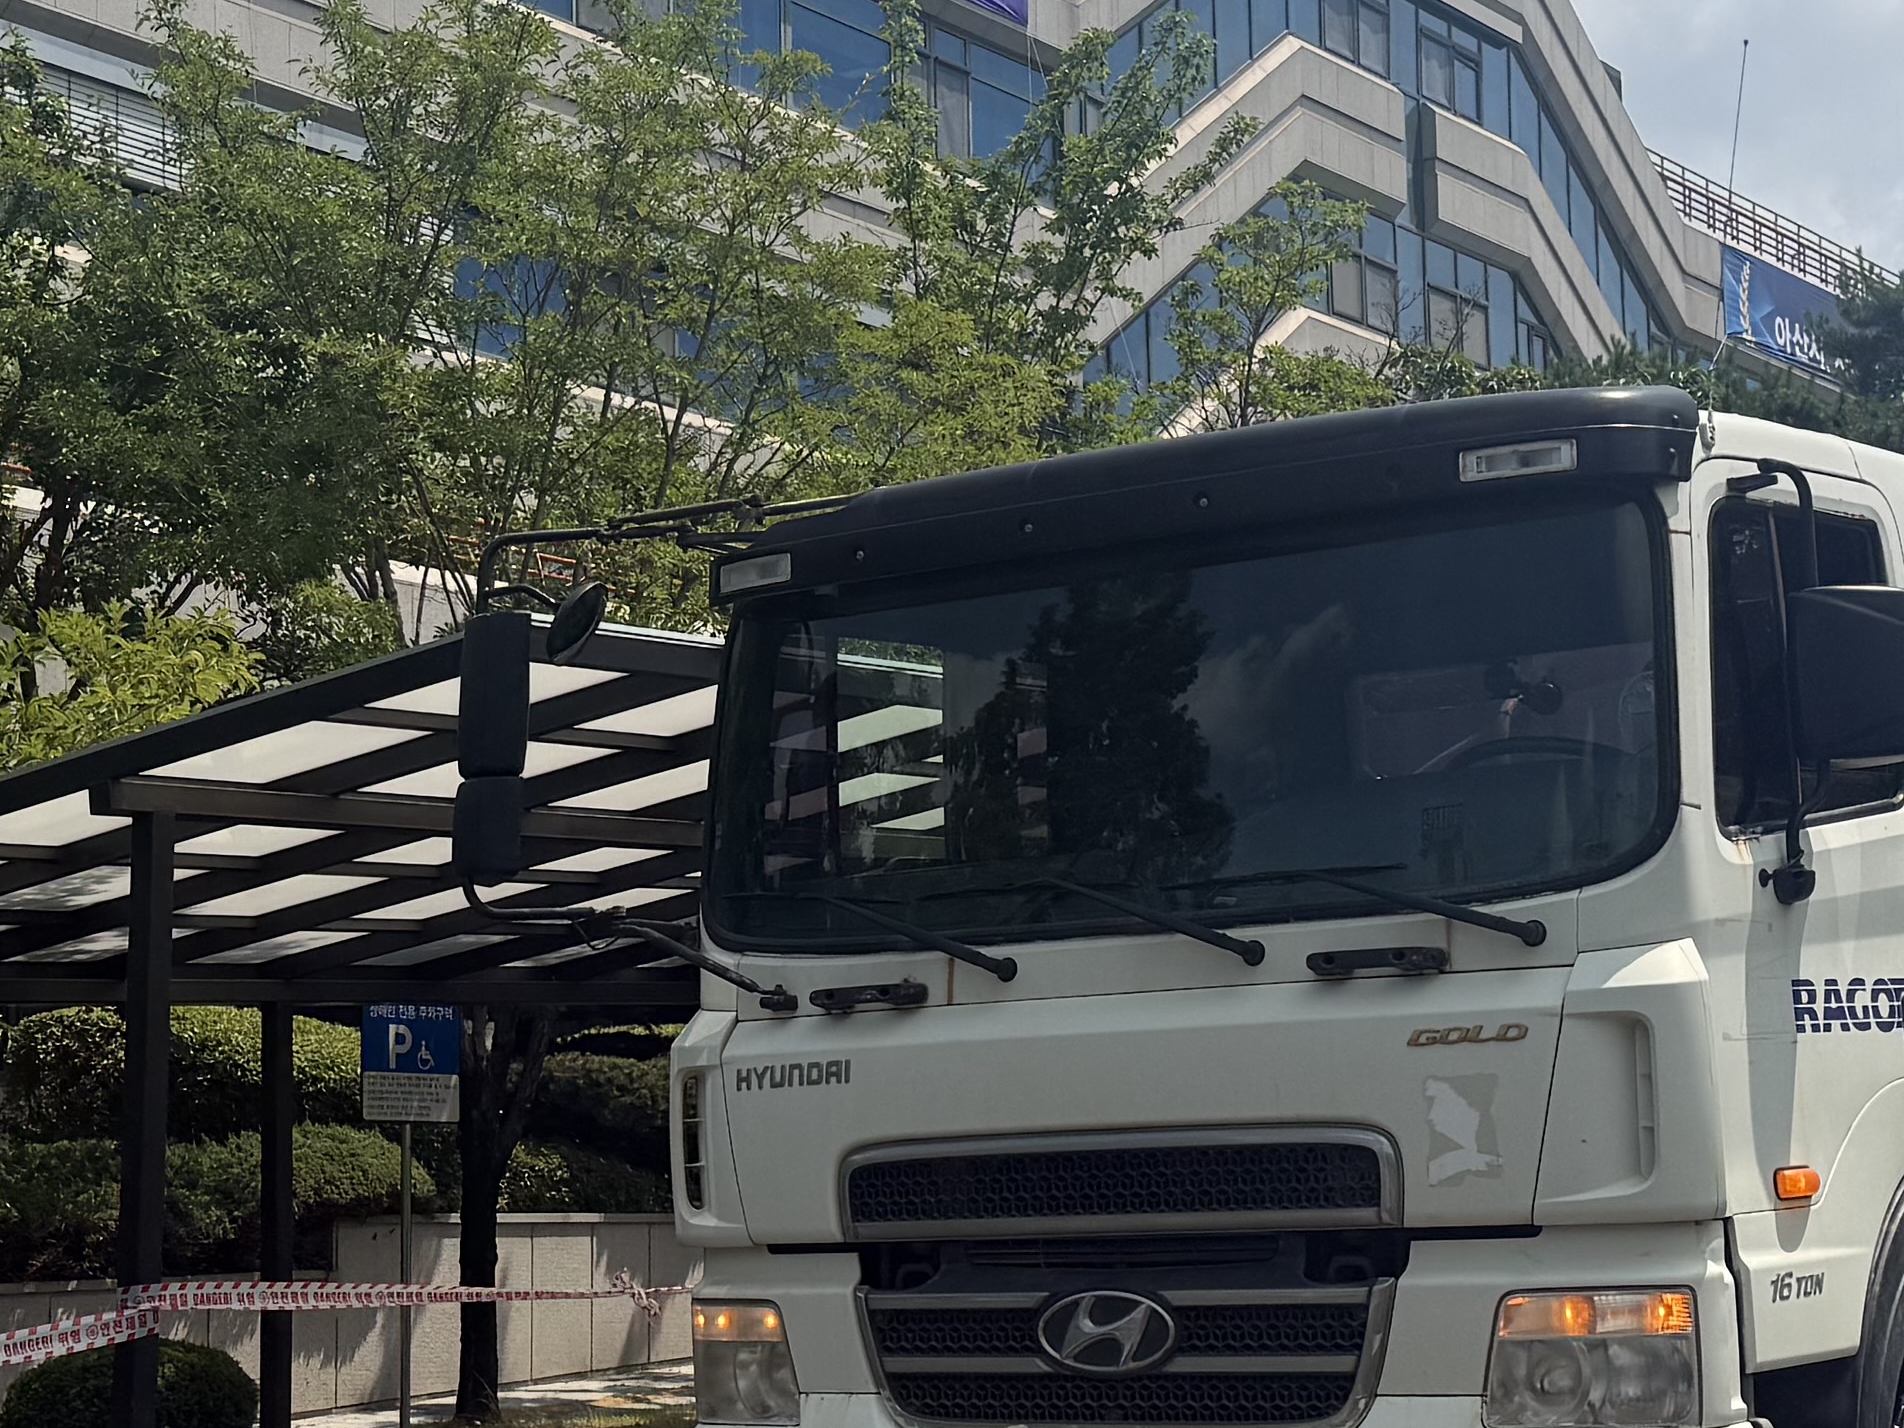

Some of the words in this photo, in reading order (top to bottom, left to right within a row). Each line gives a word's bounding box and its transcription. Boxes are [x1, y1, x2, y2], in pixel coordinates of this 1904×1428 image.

[389, 1024, 412, 1069] P
[1406, 1024, 1529, 1047] GOLD
[736, 1059, 851, 1092] HYUNDAI
[1770, 1273, 1793, 1303] 16
[1795, 1273, 1824, 1299] TON
